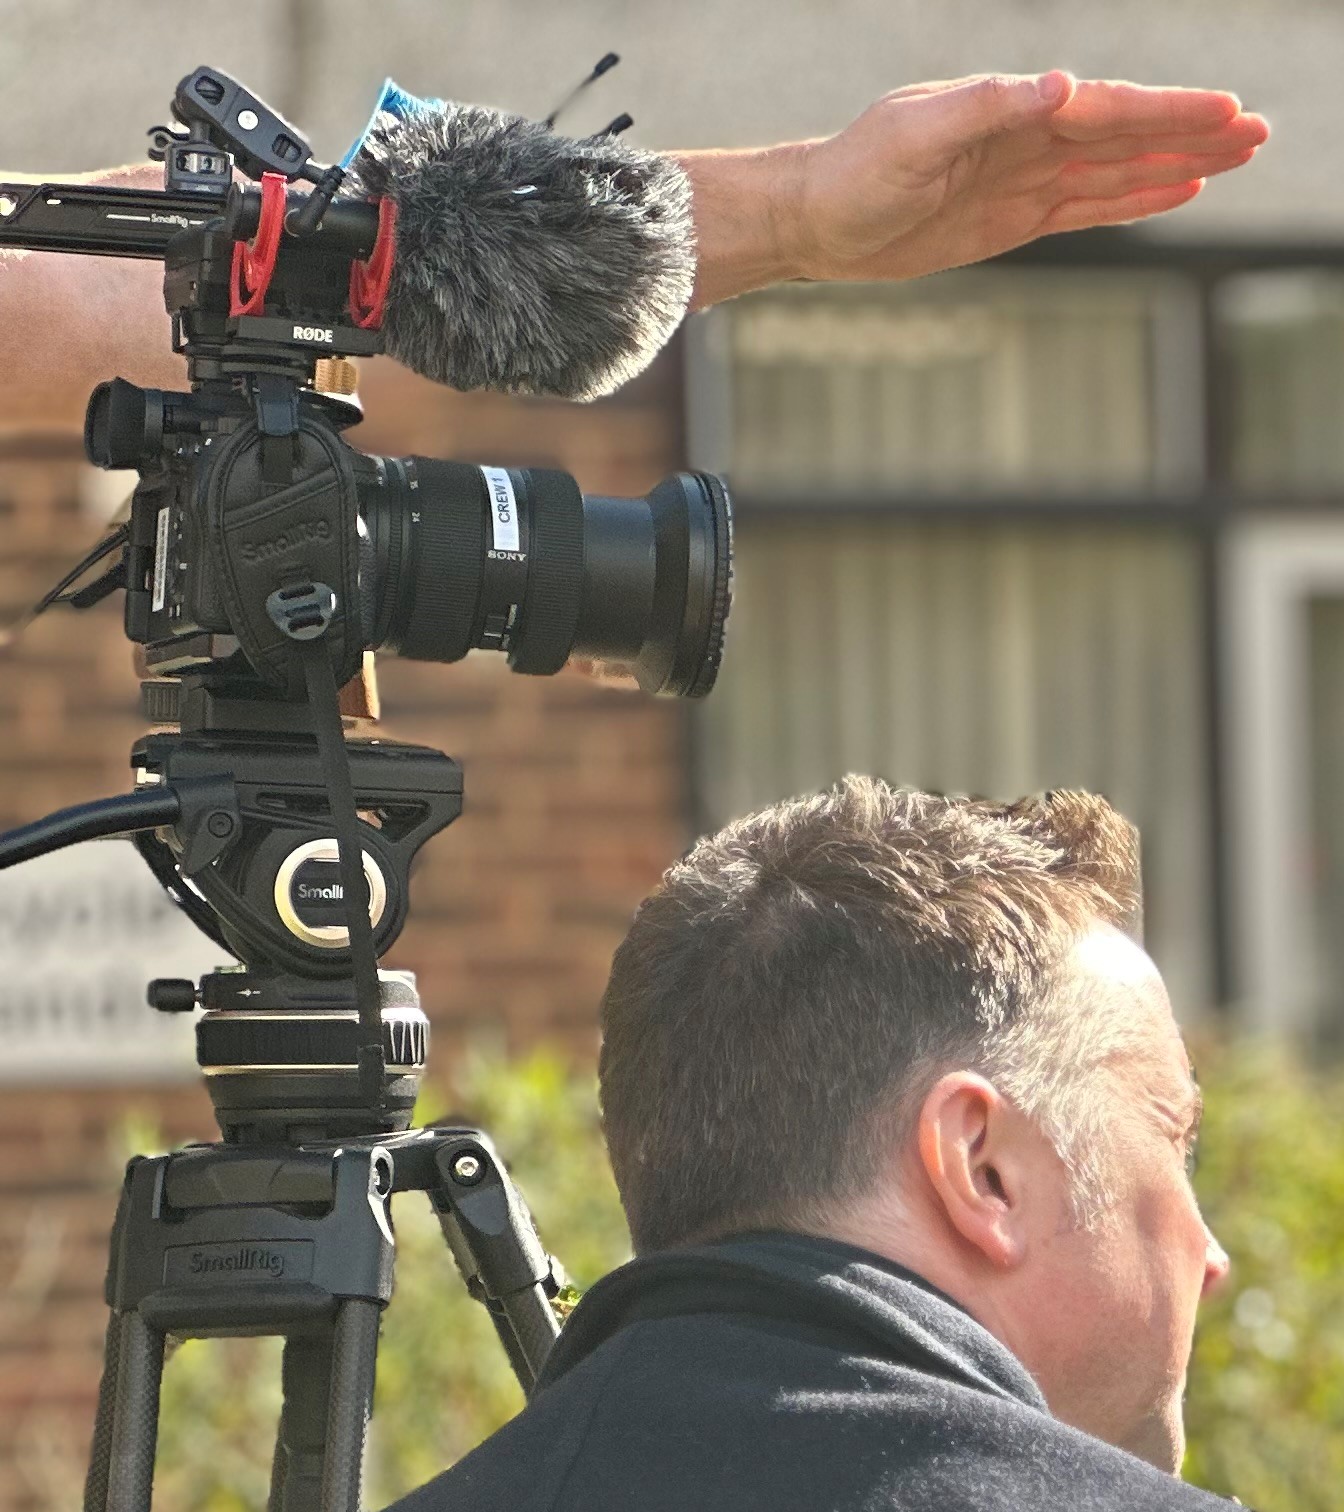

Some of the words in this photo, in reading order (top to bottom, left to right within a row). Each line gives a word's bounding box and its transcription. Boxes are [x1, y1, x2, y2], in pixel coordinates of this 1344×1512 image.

[293, 326, 333, 343] RØDE
[493, 484, 511, 524] CREW
[487, 550, 527, 562] SONY
[191, 1249, 285, 1278] SmallRig
